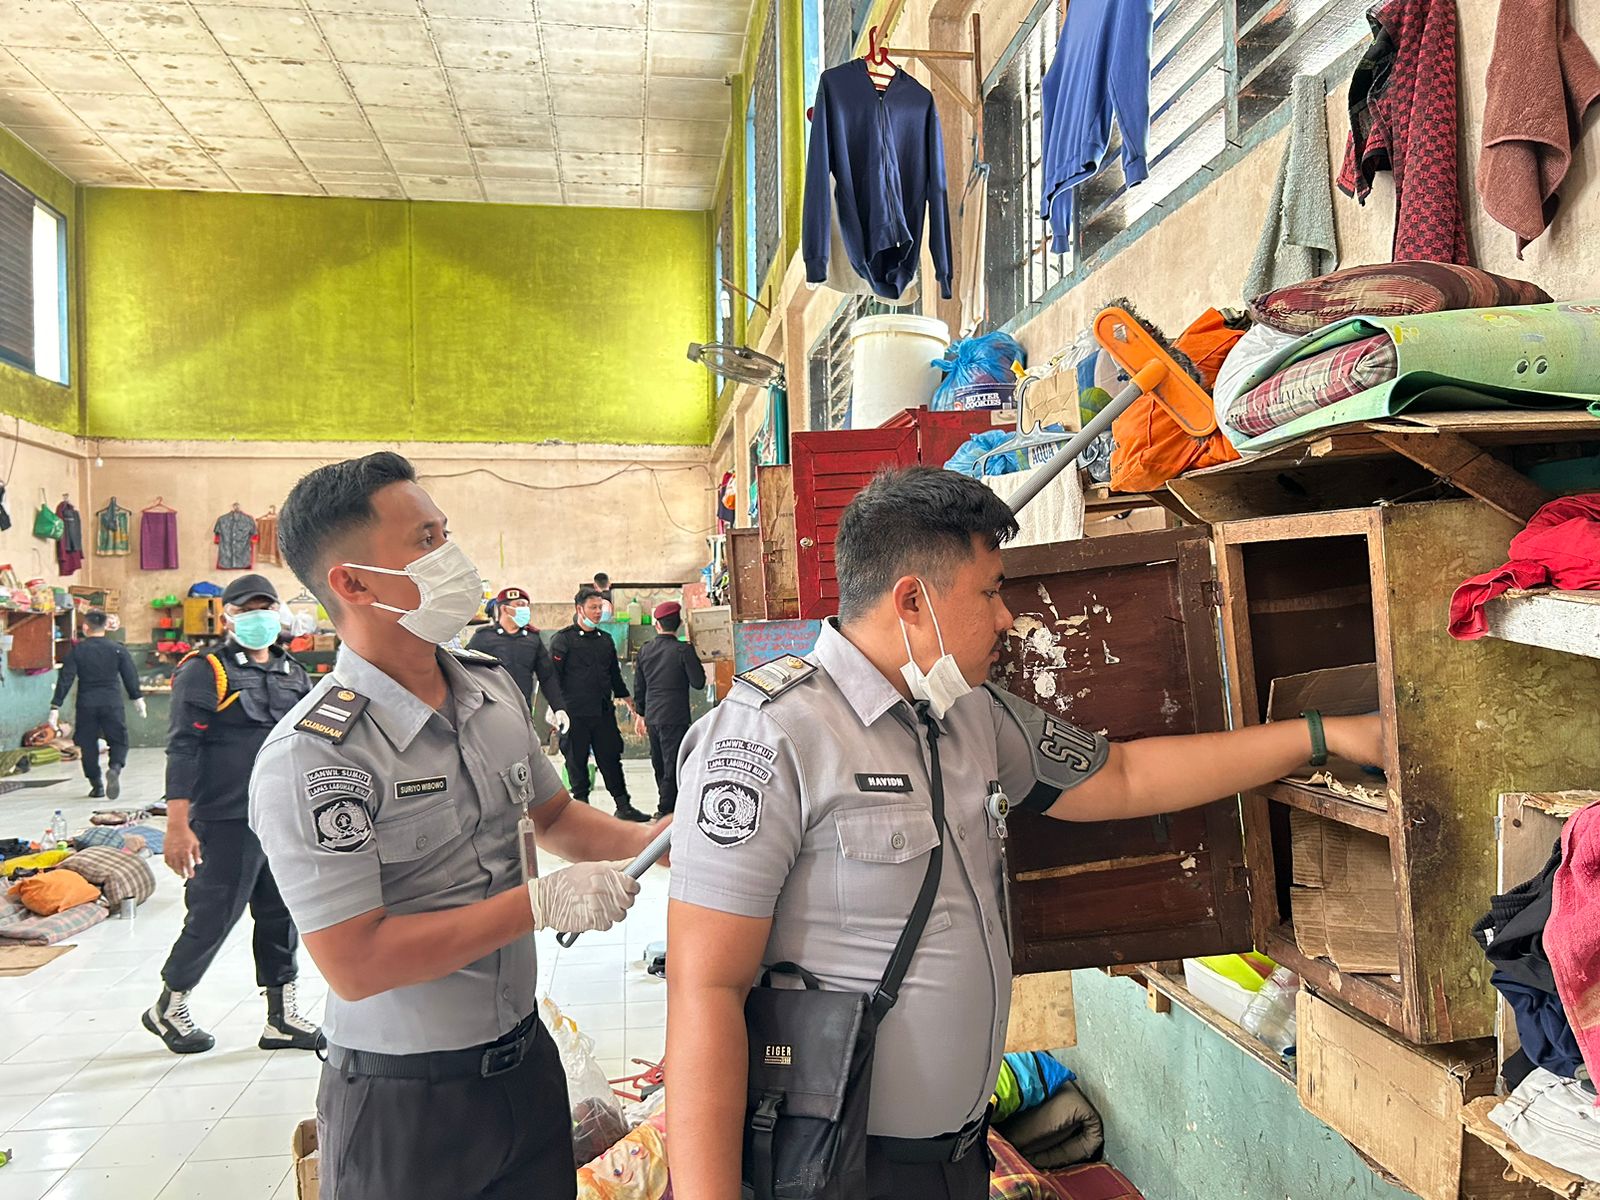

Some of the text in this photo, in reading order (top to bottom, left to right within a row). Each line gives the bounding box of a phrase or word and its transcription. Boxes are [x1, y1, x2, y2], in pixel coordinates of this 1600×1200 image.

[965, 393, 999, 403] BUTTER
[965, 399, 1001, 409] COOKIES
[1031, 443, 1055, 464] AQUA
[300, 718, 344, 738] KUMHAM
[716, 740, 774, 761] KANWIL SUMUT
[308, 768, 369, 782] KANWIL SUMUT
[309, 784, 329, 796] LAPAS
[766, 1045, 791, 1056] EIGER
